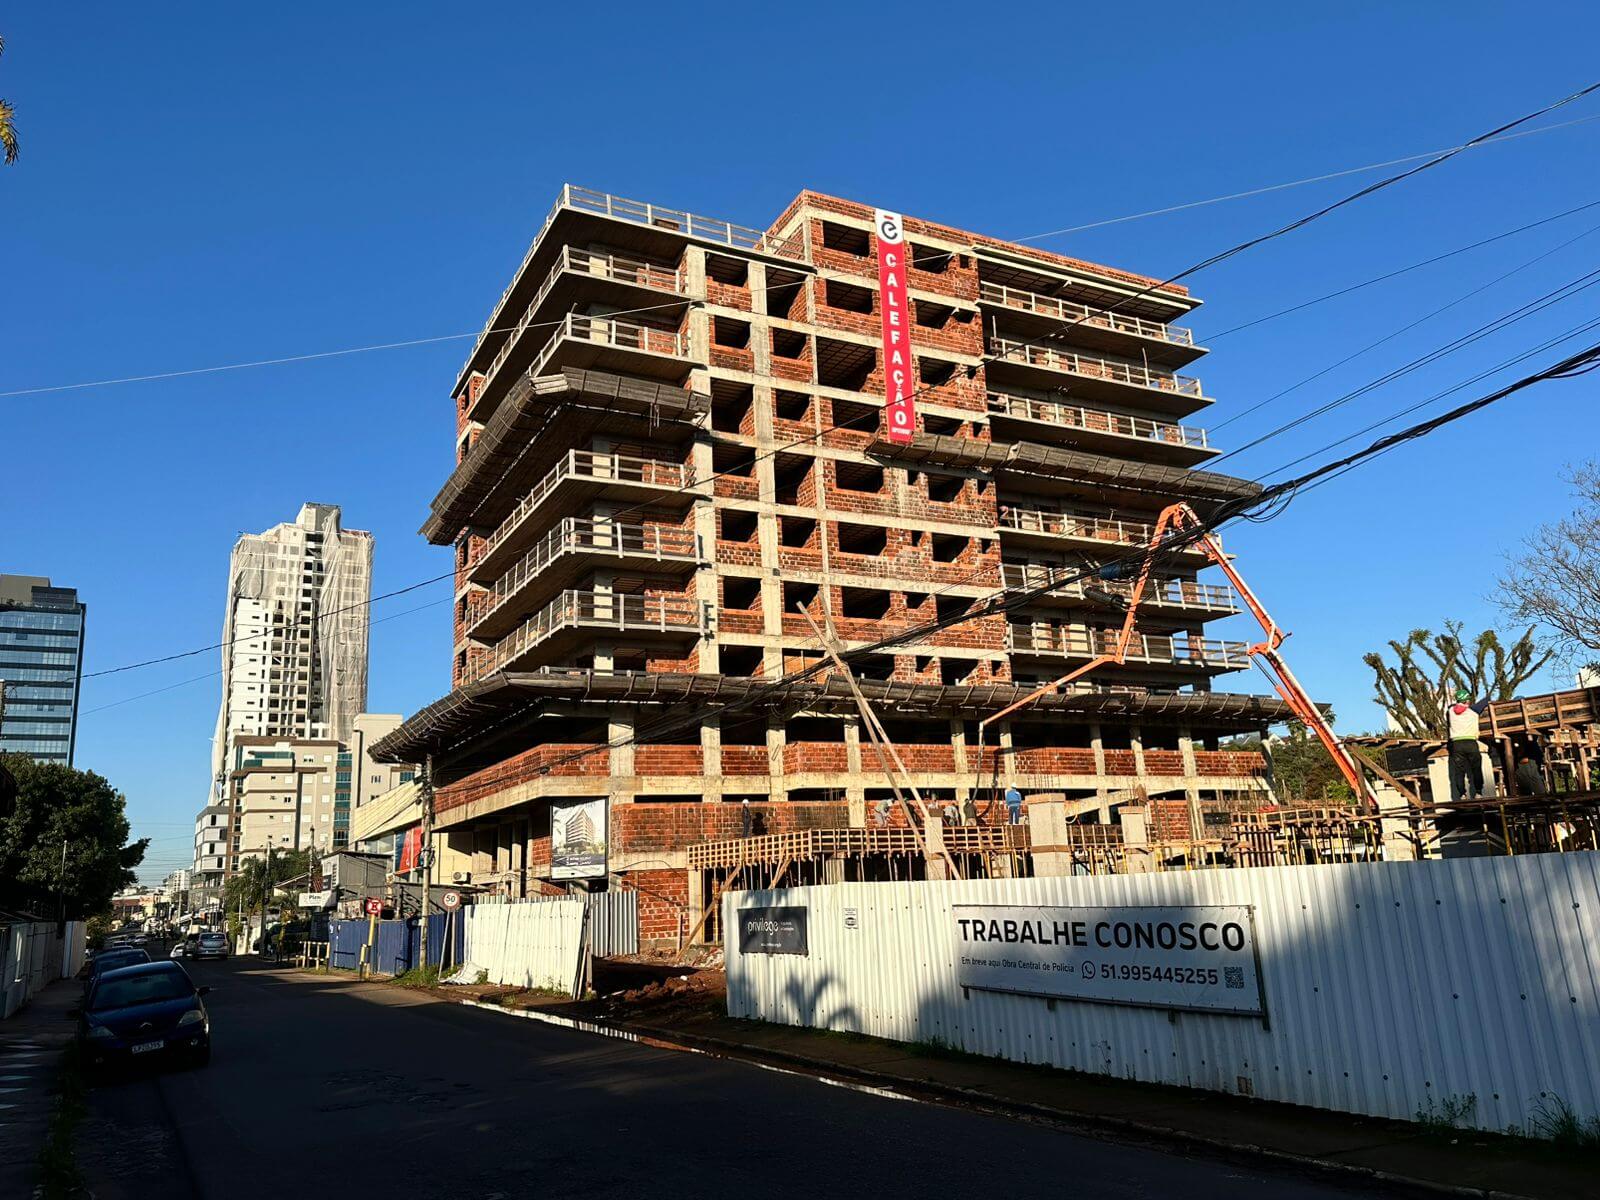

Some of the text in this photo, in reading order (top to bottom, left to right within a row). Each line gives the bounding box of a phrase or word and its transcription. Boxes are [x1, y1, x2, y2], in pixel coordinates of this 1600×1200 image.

[446, 895, 456, 903] 50
[747, 918, 779, 936] privilege
[958, 919, 1245, 951] TRABALHE CONOSCO
[961, 956, 971, 964] Em
[972, 958, 987, 966] breve
[988, 960, 1001, 968] aqui
[1002, 959, 1017, 968] Obra
[1018, 960, 1041, 970] Central
[1042, 963, 1051, 971] de
[1101, 964, 1218, 985] 51.995445255
